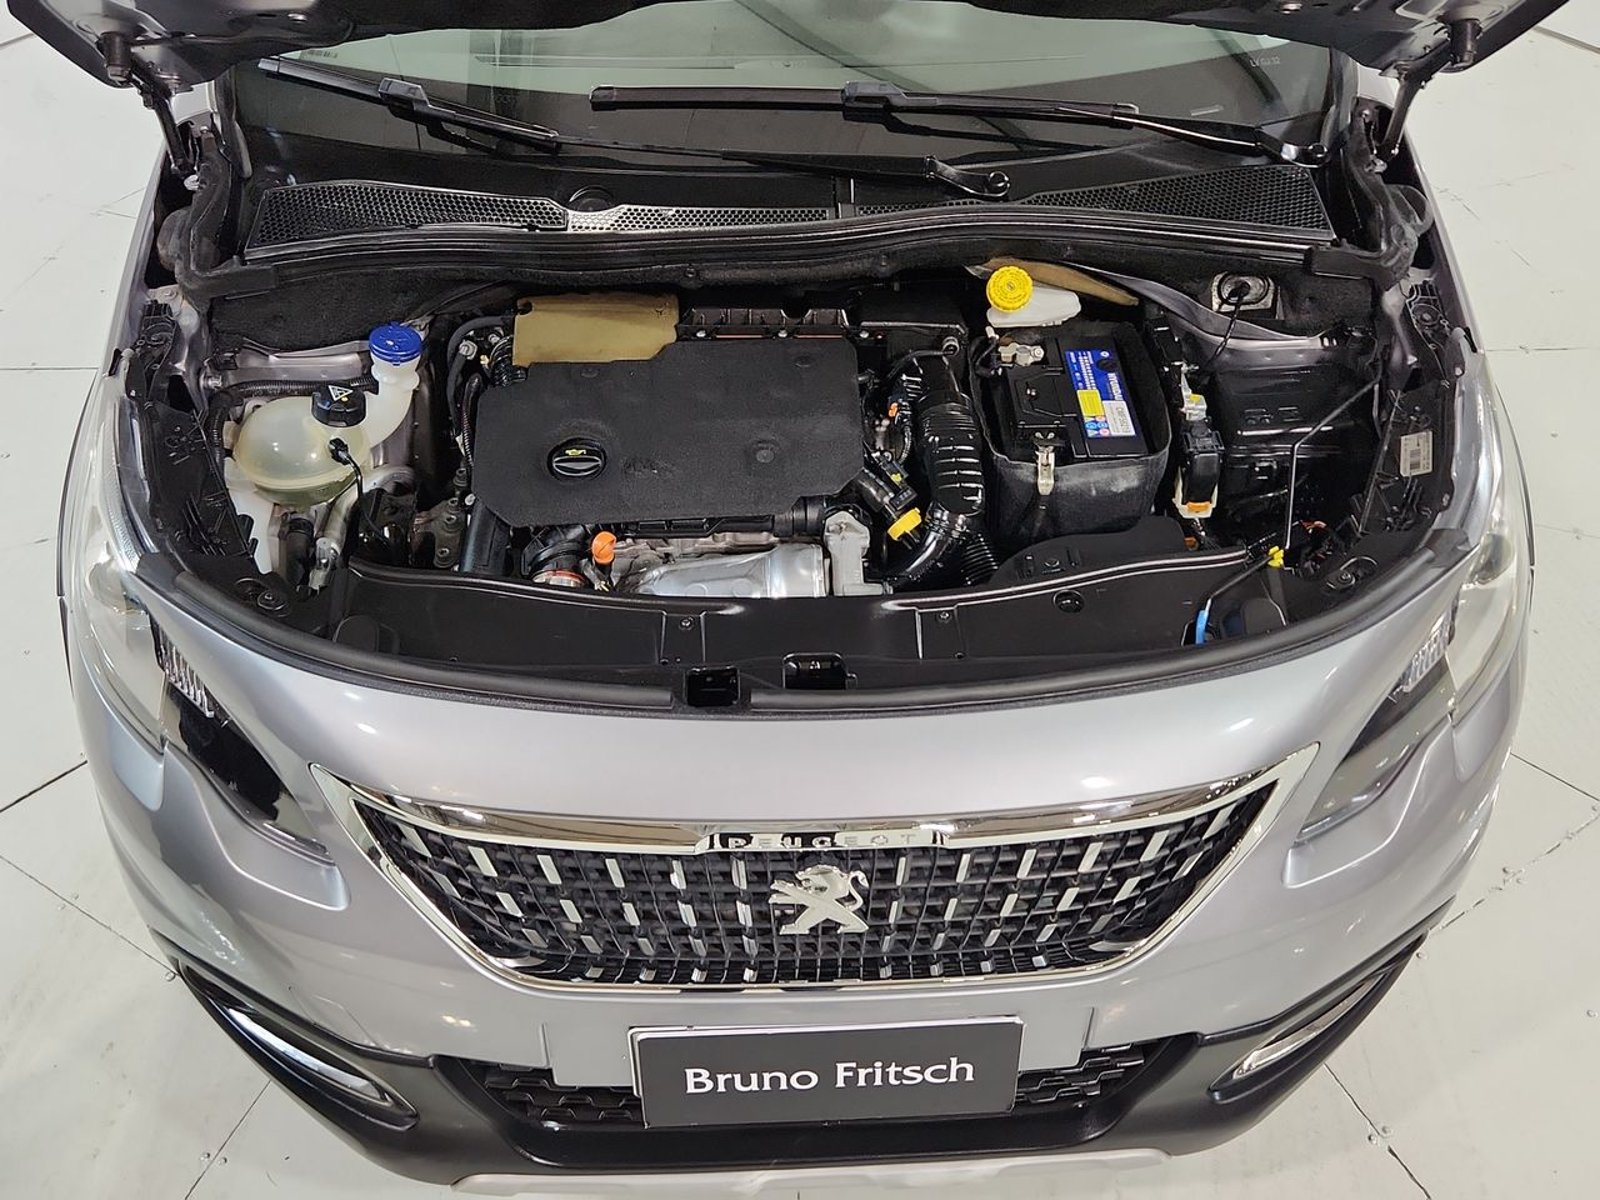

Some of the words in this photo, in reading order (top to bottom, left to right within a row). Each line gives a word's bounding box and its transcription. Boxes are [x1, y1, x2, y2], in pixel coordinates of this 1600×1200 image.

[727, 834, 917, 849] PEUGEOT
[684, 1067, 819, 1094] Bruno
[835, 1057, 975, 1088] Fritsch
